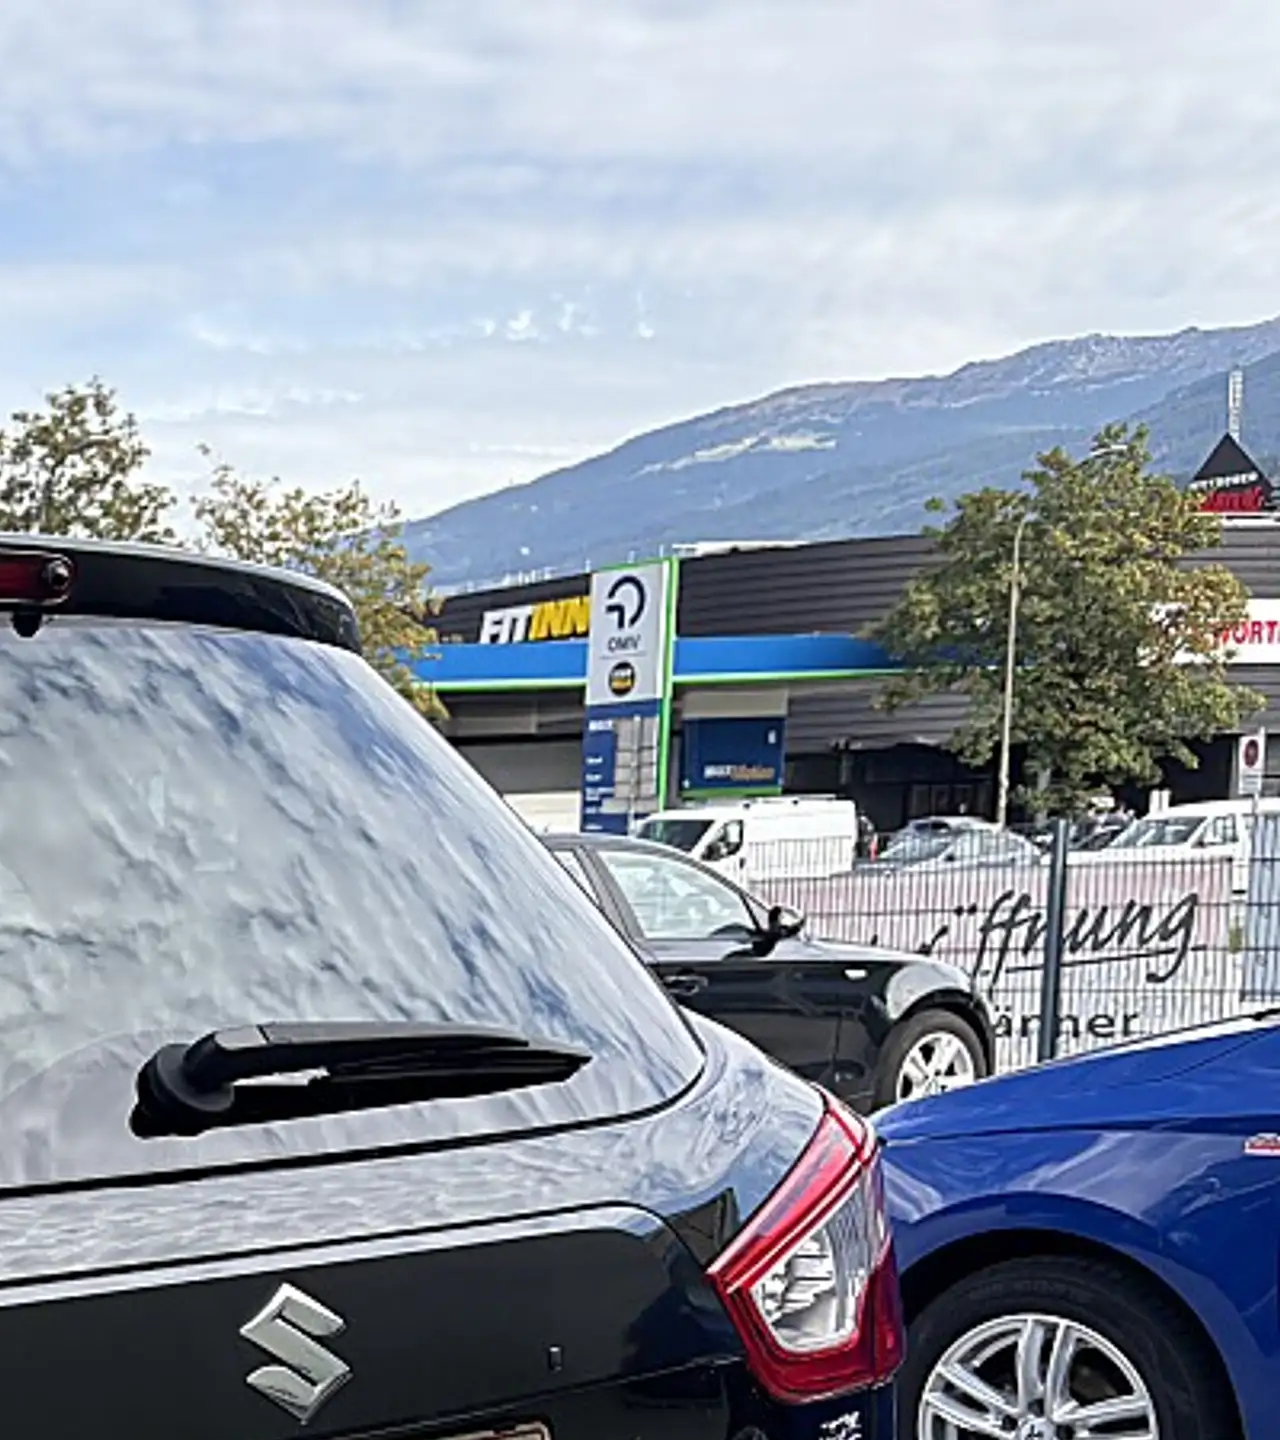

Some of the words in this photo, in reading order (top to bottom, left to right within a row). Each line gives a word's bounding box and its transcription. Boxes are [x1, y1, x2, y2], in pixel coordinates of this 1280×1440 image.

[478, 595, 592, 644] FITINN
[607, 635, 642, 653] OMV
[991, 1004, 1140, 1038] änner
